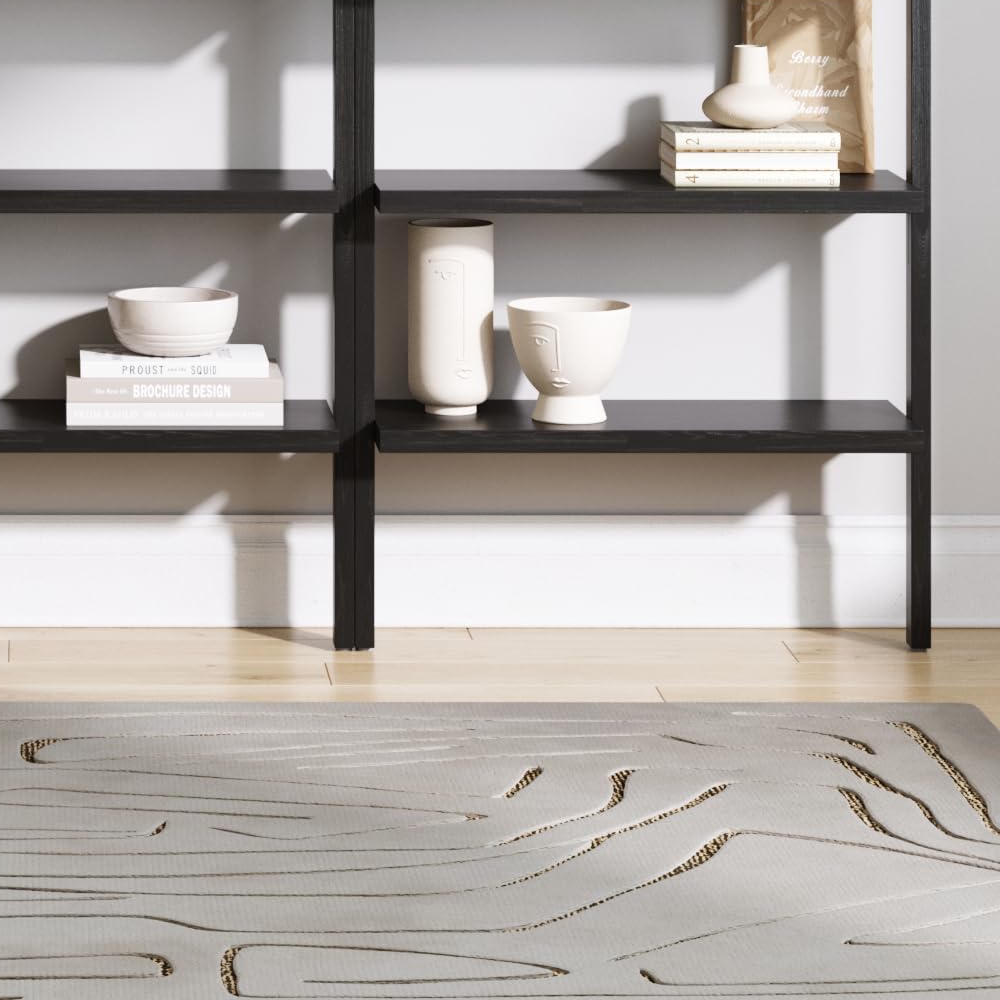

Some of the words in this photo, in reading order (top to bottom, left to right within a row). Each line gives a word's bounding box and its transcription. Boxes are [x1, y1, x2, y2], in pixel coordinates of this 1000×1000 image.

[685, 137, 700, 145] 2
[685, 174, 700, 184] 4
[121, 365, 165, 375] PROUST
[190, 365, 218, 375] SQUID
[133, 384, 191, 399] BROCHURE
[193, 384, 232, 399] DESIGN
